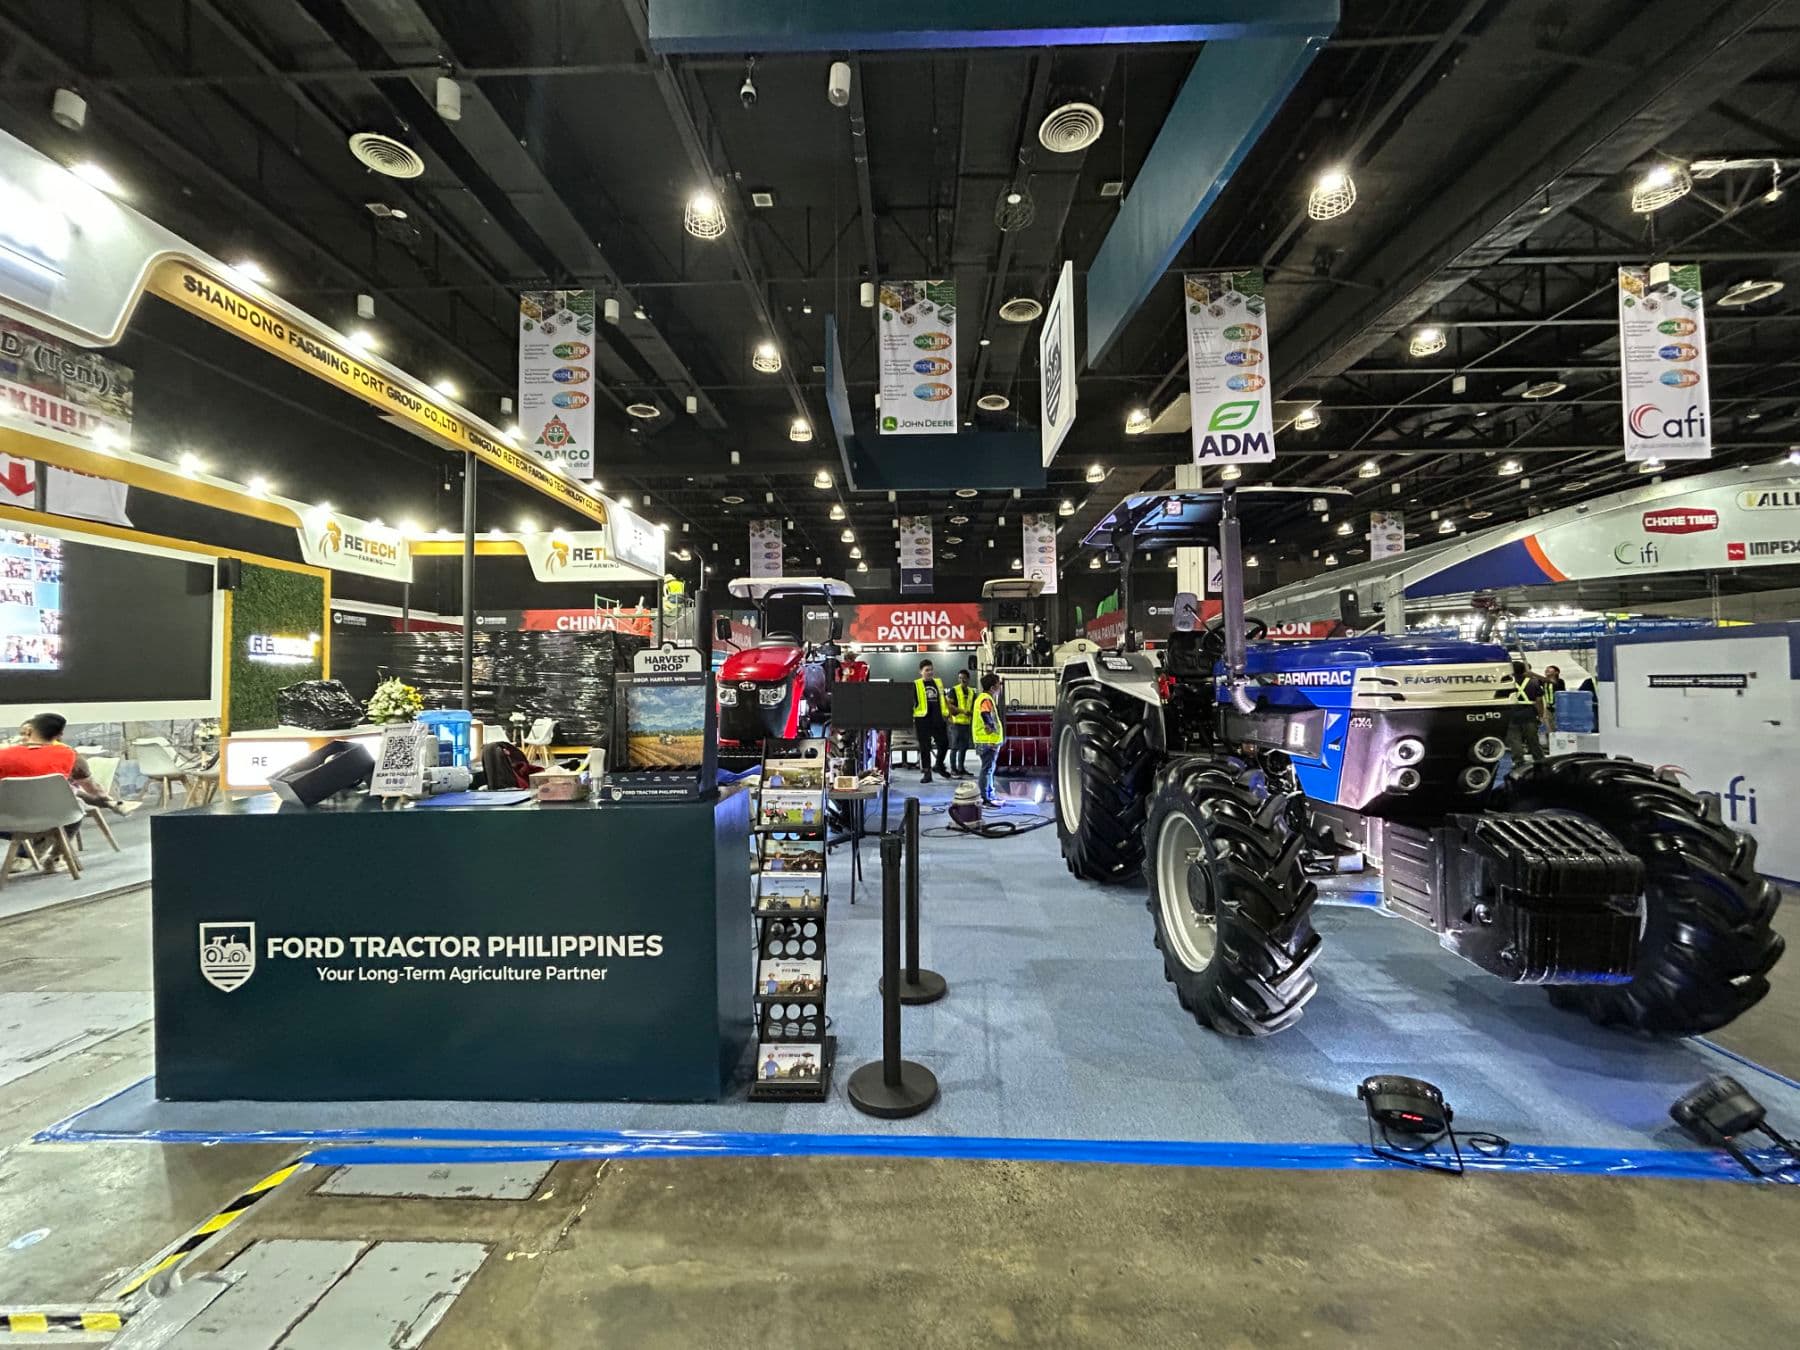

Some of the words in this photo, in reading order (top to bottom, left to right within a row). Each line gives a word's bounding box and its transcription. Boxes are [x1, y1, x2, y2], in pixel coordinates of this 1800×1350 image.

[183, 274, 284, 339] SHANDONG
[288, 331, 350, 375] FARMING
[353, 367, 385, 393] PORT
[387, 386, 422, 412] GROUP
[424, 407, 458, 433] CO.,LTD
[33, 343, 110, 397] (Tent)
[899, 420, 924, 428] JOHN
[925, 419, 954, 428] DEERE
[1198, 432, 1270, 458] ADM
[1644, 515, 1686, 527] CHORE
[1687, 514, 1717, 525] TIME
[344, 534, 397, 560] RETECH
[358, 554, 384, 566] FARMING
[556, 616, 616, 631] CHINA
[890, 611, 951, 626] CHINA
[877, 625, 965, 641] PAVILION
[644, 655, 690, 664] HARVEST
[653, 663, 683, 672] DROP
[1277, 670, 1352, 686] FARMTRAC
[1404, 675, 1497, 685] FARMTRAC
[266, 936, 345, 960] FORD
[349, 936, 481, 959] TRACTOR
[487, 934, 664, 958] PHILIPPINES
[316, 966, 354, 982] Your
[358, 966, 446, 984] Long-Term
[449, 965, 542, 984] Agriculture
[545, 966, 608, 981] Partner
